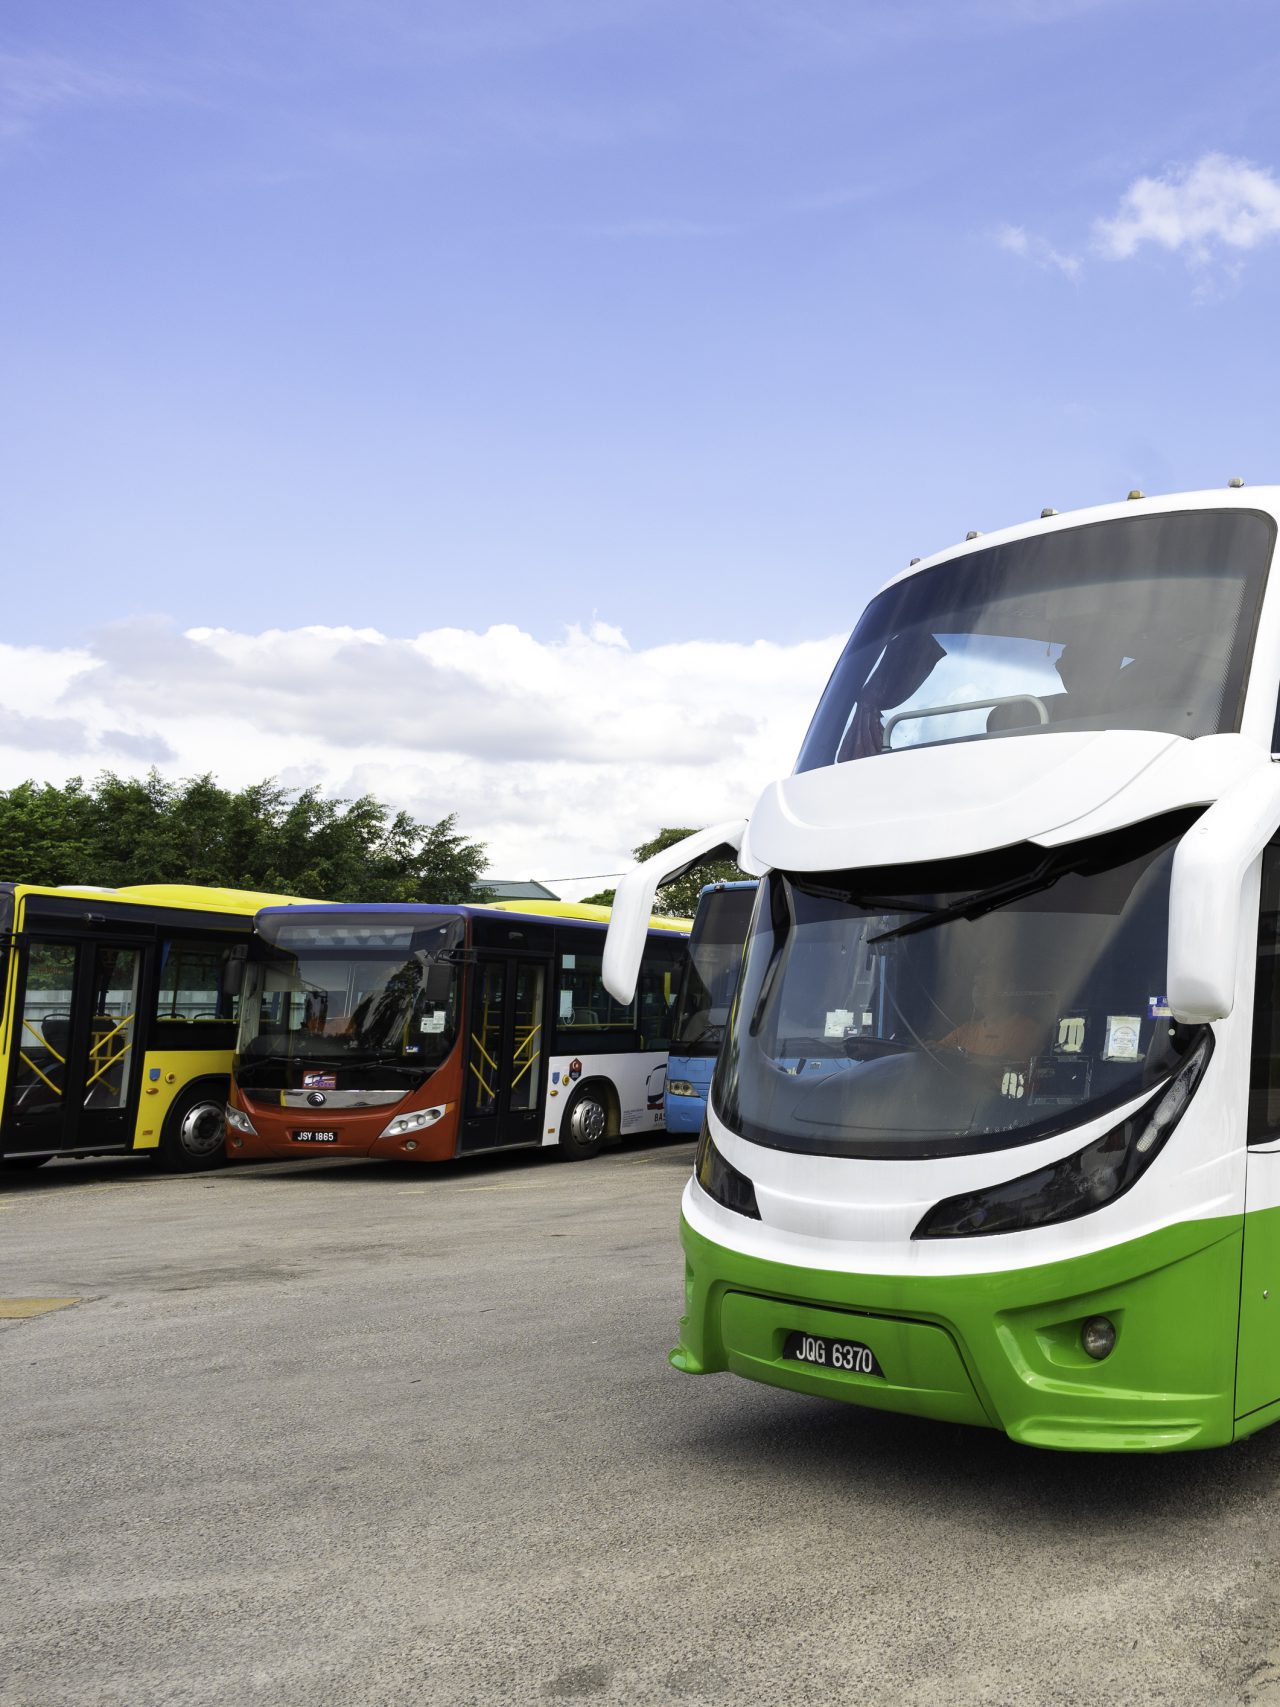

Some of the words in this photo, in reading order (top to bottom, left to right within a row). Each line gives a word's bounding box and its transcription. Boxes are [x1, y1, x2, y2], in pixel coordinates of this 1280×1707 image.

[297, 1132, 312, 1141] JSY
[315, 1132, 334, 1141] 1865
[796, 1337, 826, 1364] JQG
[832, 1344, 872, 1373] 6370
